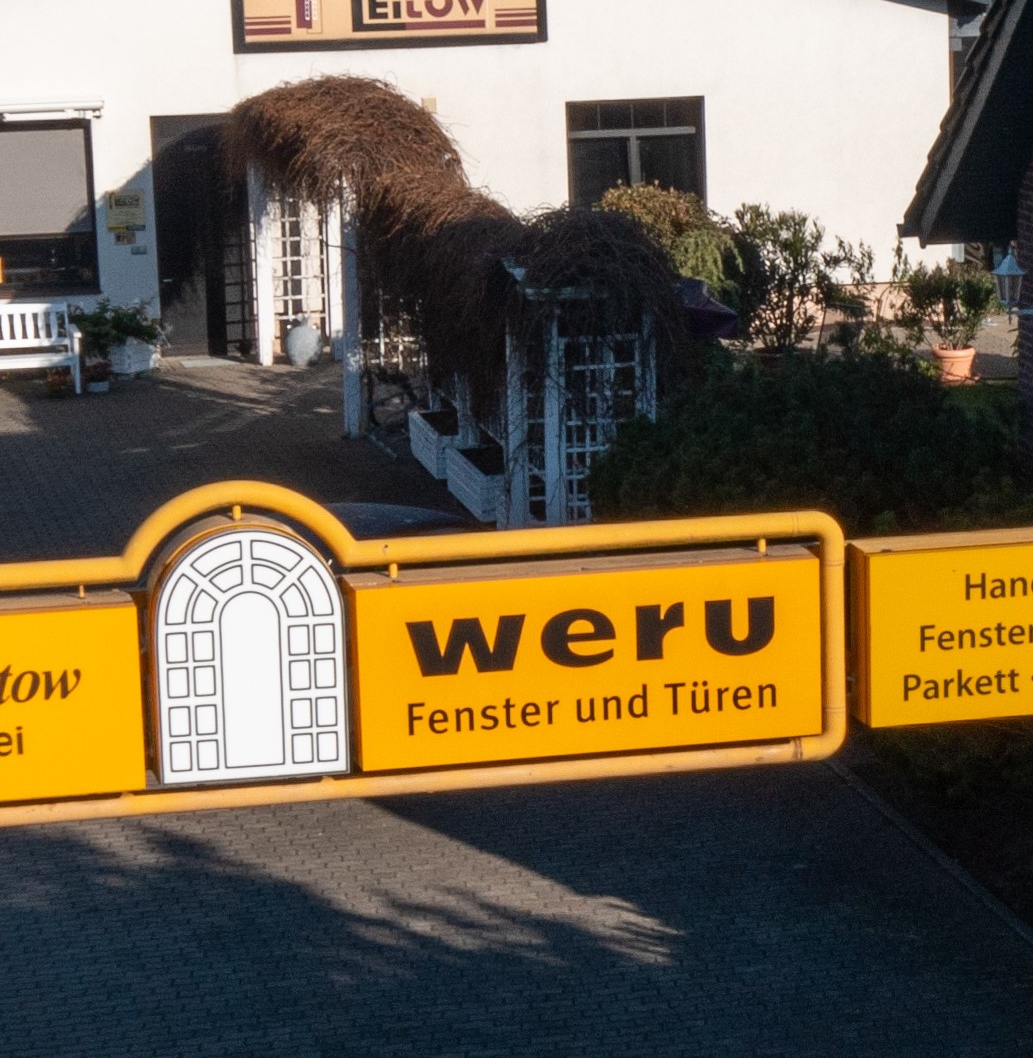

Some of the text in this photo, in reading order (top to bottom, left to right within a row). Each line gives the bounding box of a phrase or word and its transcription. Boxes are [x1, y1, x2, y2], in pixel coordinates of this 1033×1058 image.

[965, 571, 1033, 601] Han
[405, 594, 776, 679] weru
[407, 679, 777, 736] Fenster und Türen
[903, 668, 1020, 702] Parkett
